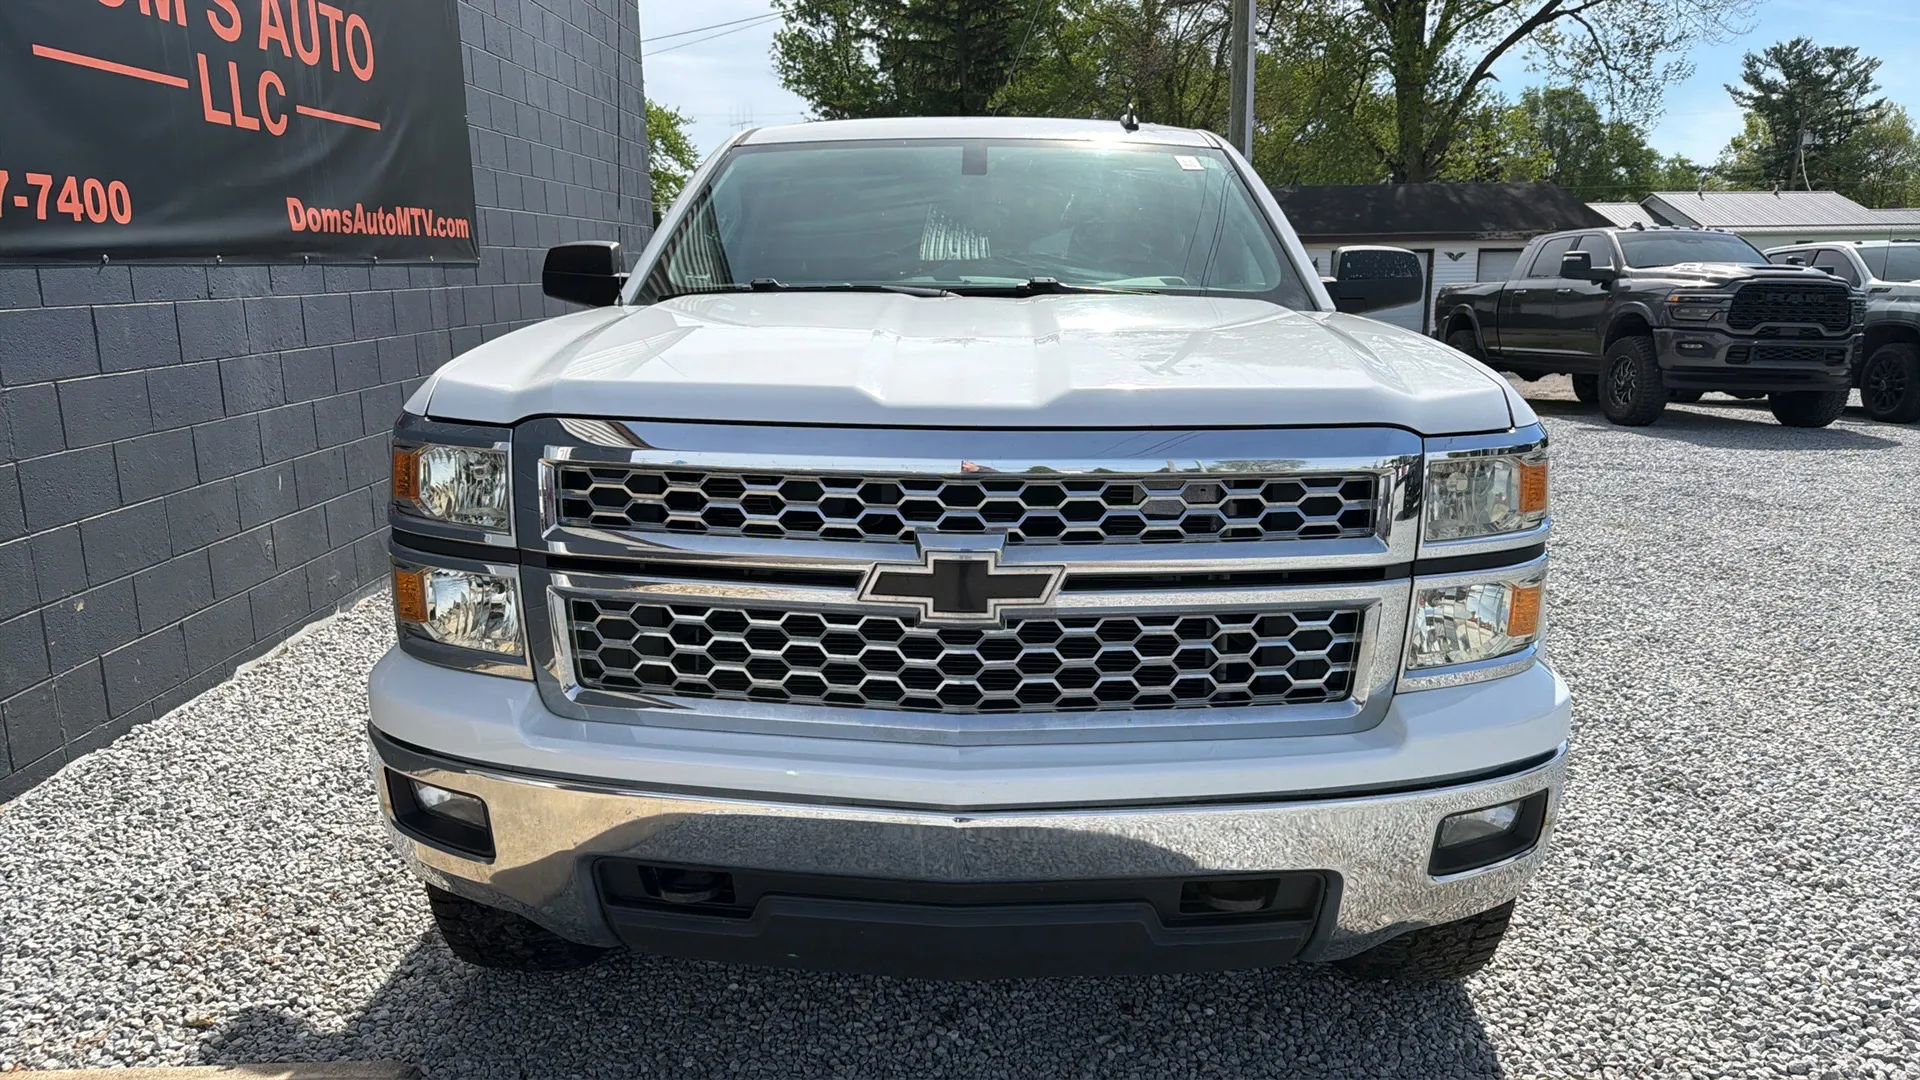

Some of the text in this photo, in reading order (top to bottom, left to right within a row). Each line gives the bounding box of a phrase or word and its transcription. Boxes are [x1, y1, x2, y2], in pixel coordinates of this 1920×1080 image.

[260, 0, 375, 81] AUTO
[198, 54, 289, 136] LLC
[287, 197, 470, 239] DomsAutoMTV.com
[1765, 292, 1825, 304] RAM
